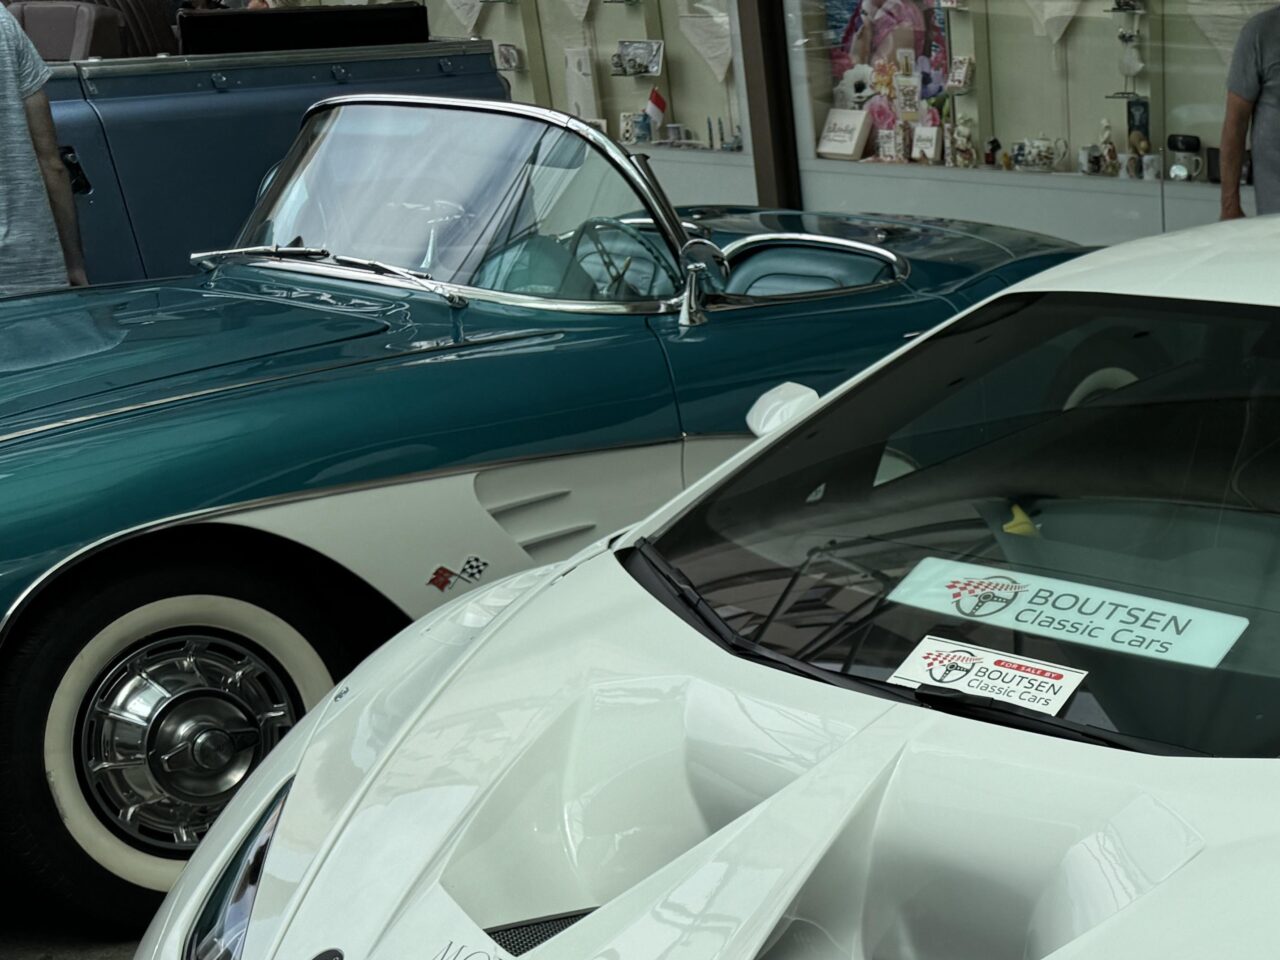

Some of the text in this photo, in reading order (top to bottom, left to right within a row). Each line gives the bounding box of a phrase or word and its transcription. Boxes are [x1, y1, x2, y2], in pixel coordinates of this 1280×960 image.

[1027, 588, 1192, 636] BOUTSEN
[1014, 608, 1173, 654] Classic Cars
[975, 666, 1063, 696] BOUTSEN
[1000, 661, 1057, 679] FOR SALE BY
[967, 678, 1052, 706] Classic Cars
